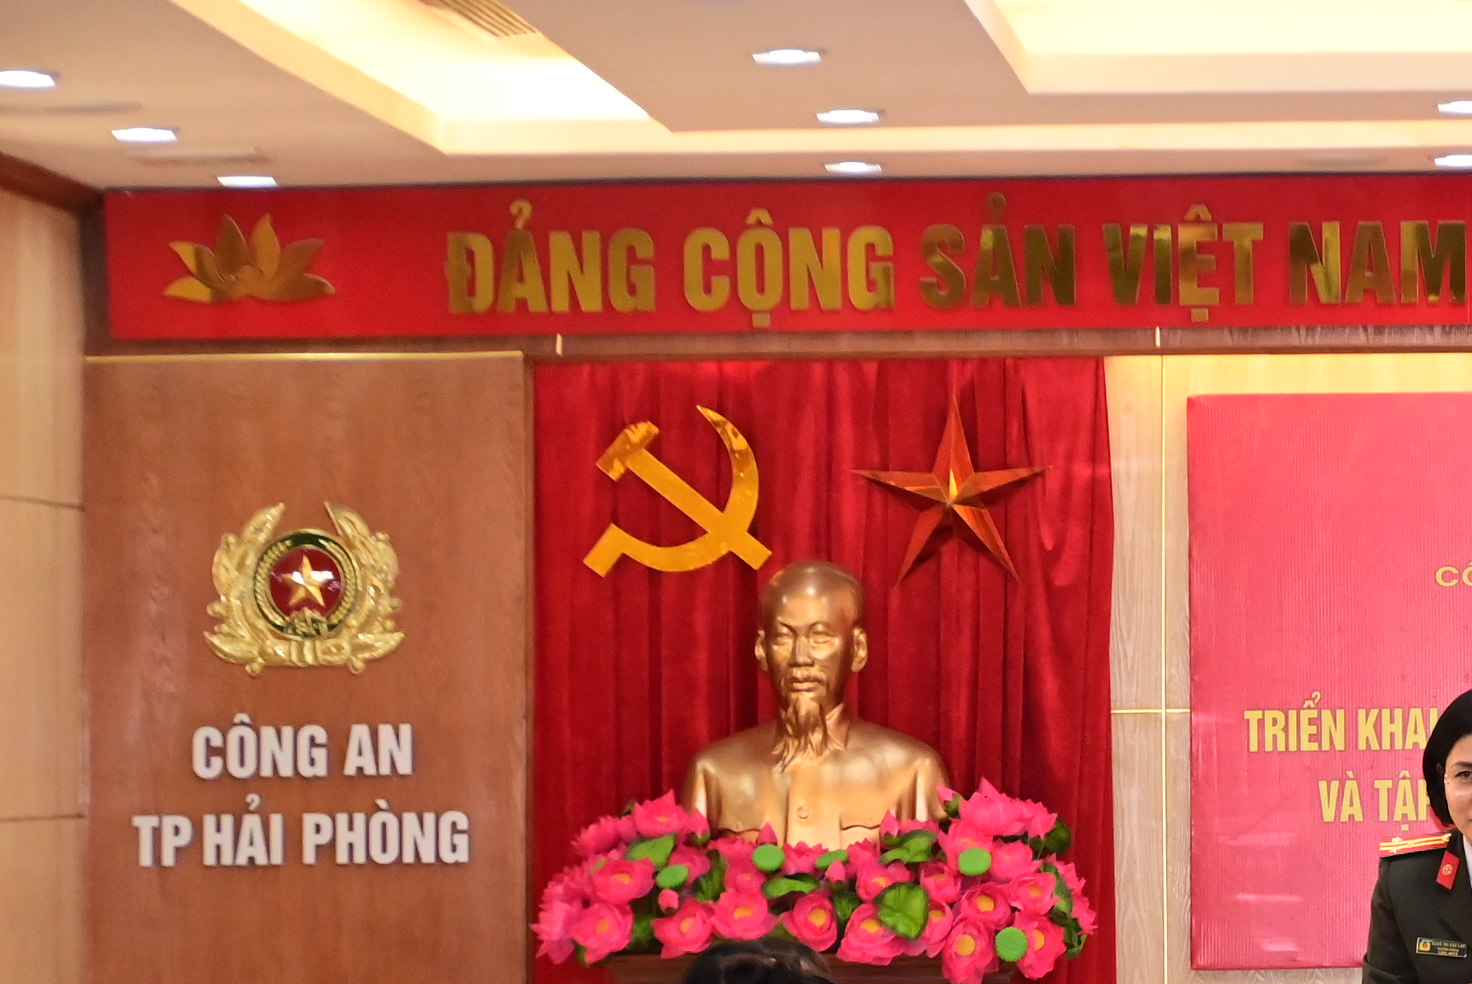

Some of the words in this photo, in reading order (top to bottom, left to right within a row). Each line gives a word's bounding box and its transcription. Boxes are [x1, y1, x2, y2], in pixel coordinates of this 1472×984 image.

[444, 199, 657, 315] ĐẢNG
[683, 207, 894, 328] CỘNG
[919, 193, 1076, 308] SẢN
[1103, 203, 1264, 322] VIỆT
[1289, 220, 1467, 305] NAM
[192, 712, 328, 780] CÔNG
[343, 723, 413, 776] AN
[1244, 691, 1345, 752] TRIỂN
[132, 814, 193, 867] TP
[203, 793, 284, 866] HẢI
[302, 798, 470, 864] PHÒNG
[1318, 771, 1364, 822] VÀ
